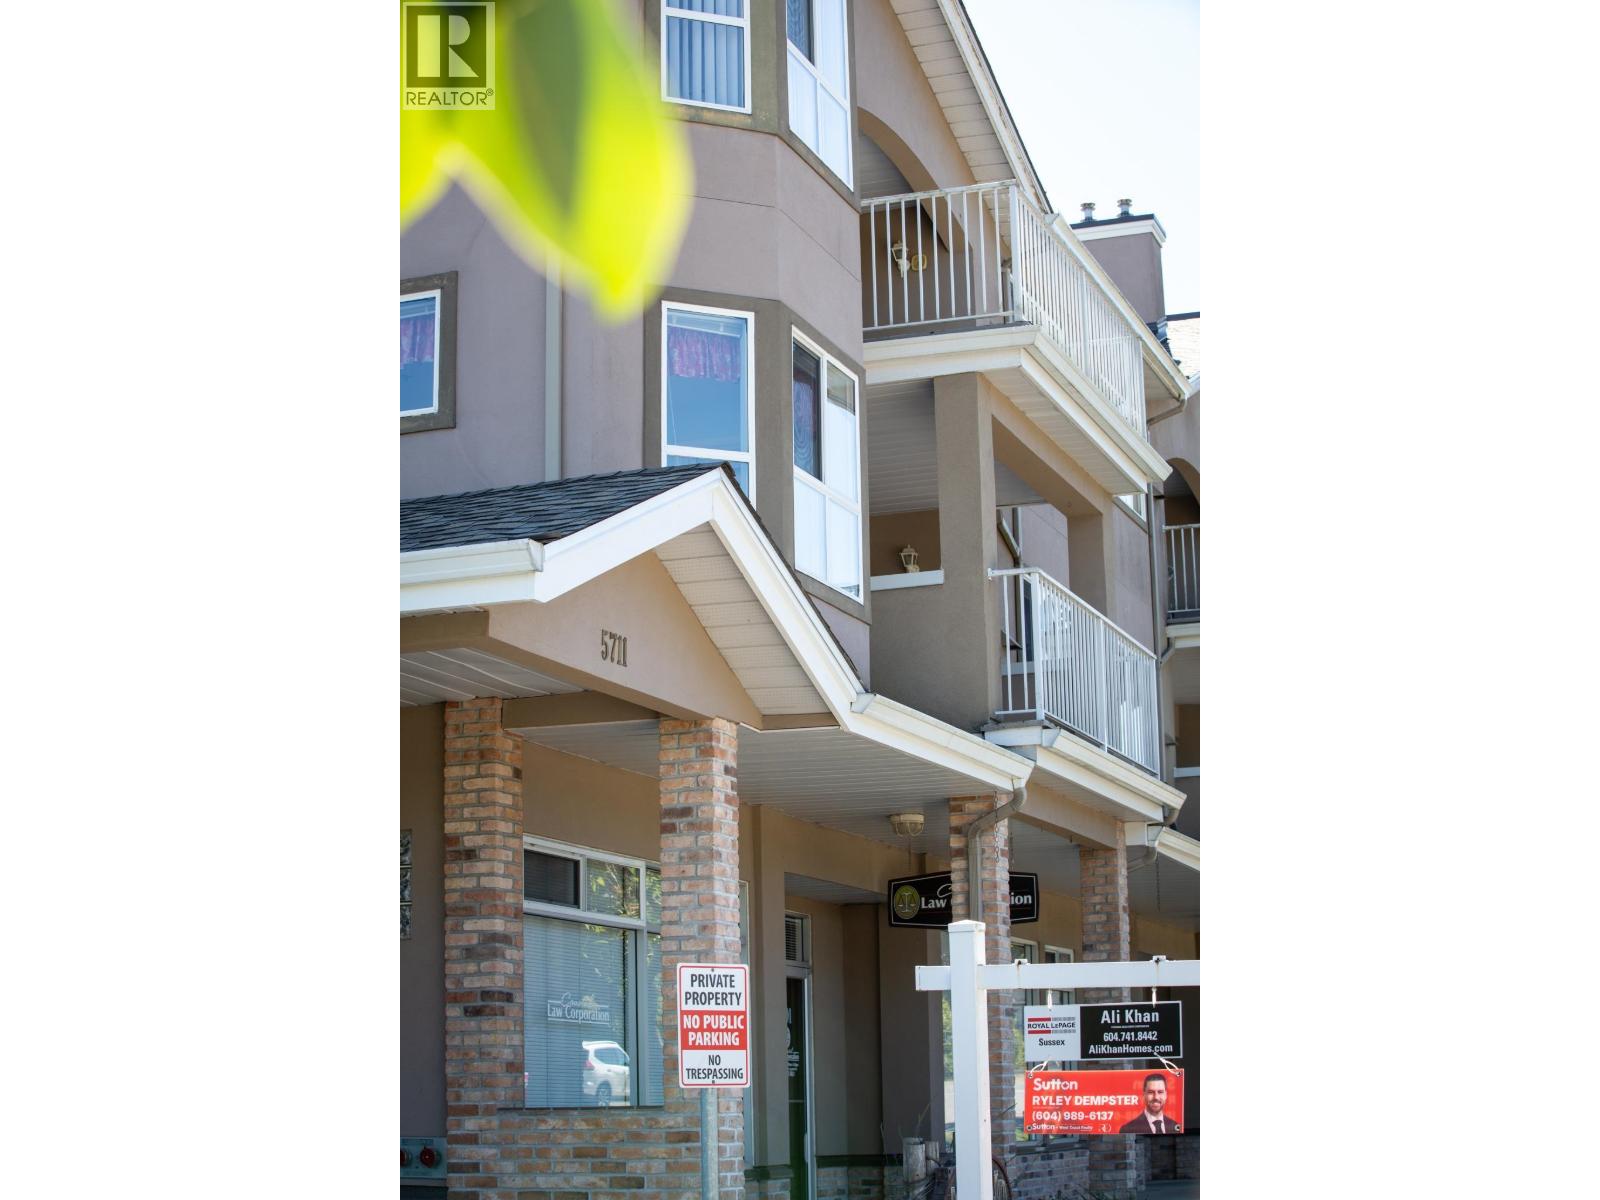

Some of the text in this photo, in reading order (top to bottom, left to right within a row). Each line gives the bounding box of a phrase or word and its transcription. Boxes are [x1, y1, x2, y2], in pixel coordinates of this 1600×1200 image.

[601, 628, 628, 667] 5711
[921, 897, 947, 909] Law
[690, 973, 735, 988] PRIVATE
[684, 991, 742, 1006] PROPERTY
[547, 1002, 610, 1024] Law Corporation
[1101, 1009, 1160, 1024] Ali Khan
[683, 1014, 744, 1029] NO PUBLIC
[688, 1031, 740, 1046] PARKING
[1038, 1038, 1065, 1046] Sussex
[1103, 1031, 1158, 1042] 604.741.8442
[1088, 1044, 1173, 1054] AliKhanHomes.com
[708, 1054, 721, 1066] NO
[686, 1067, 743, 1080] TRESPASSING
[1033, 1077, 1078, 1091] Sutton
[1032, 1095, 1138, 1106] RYLEY DEMPSTER
[1032, 1111, 1114, 1121] (604) 989-6137
